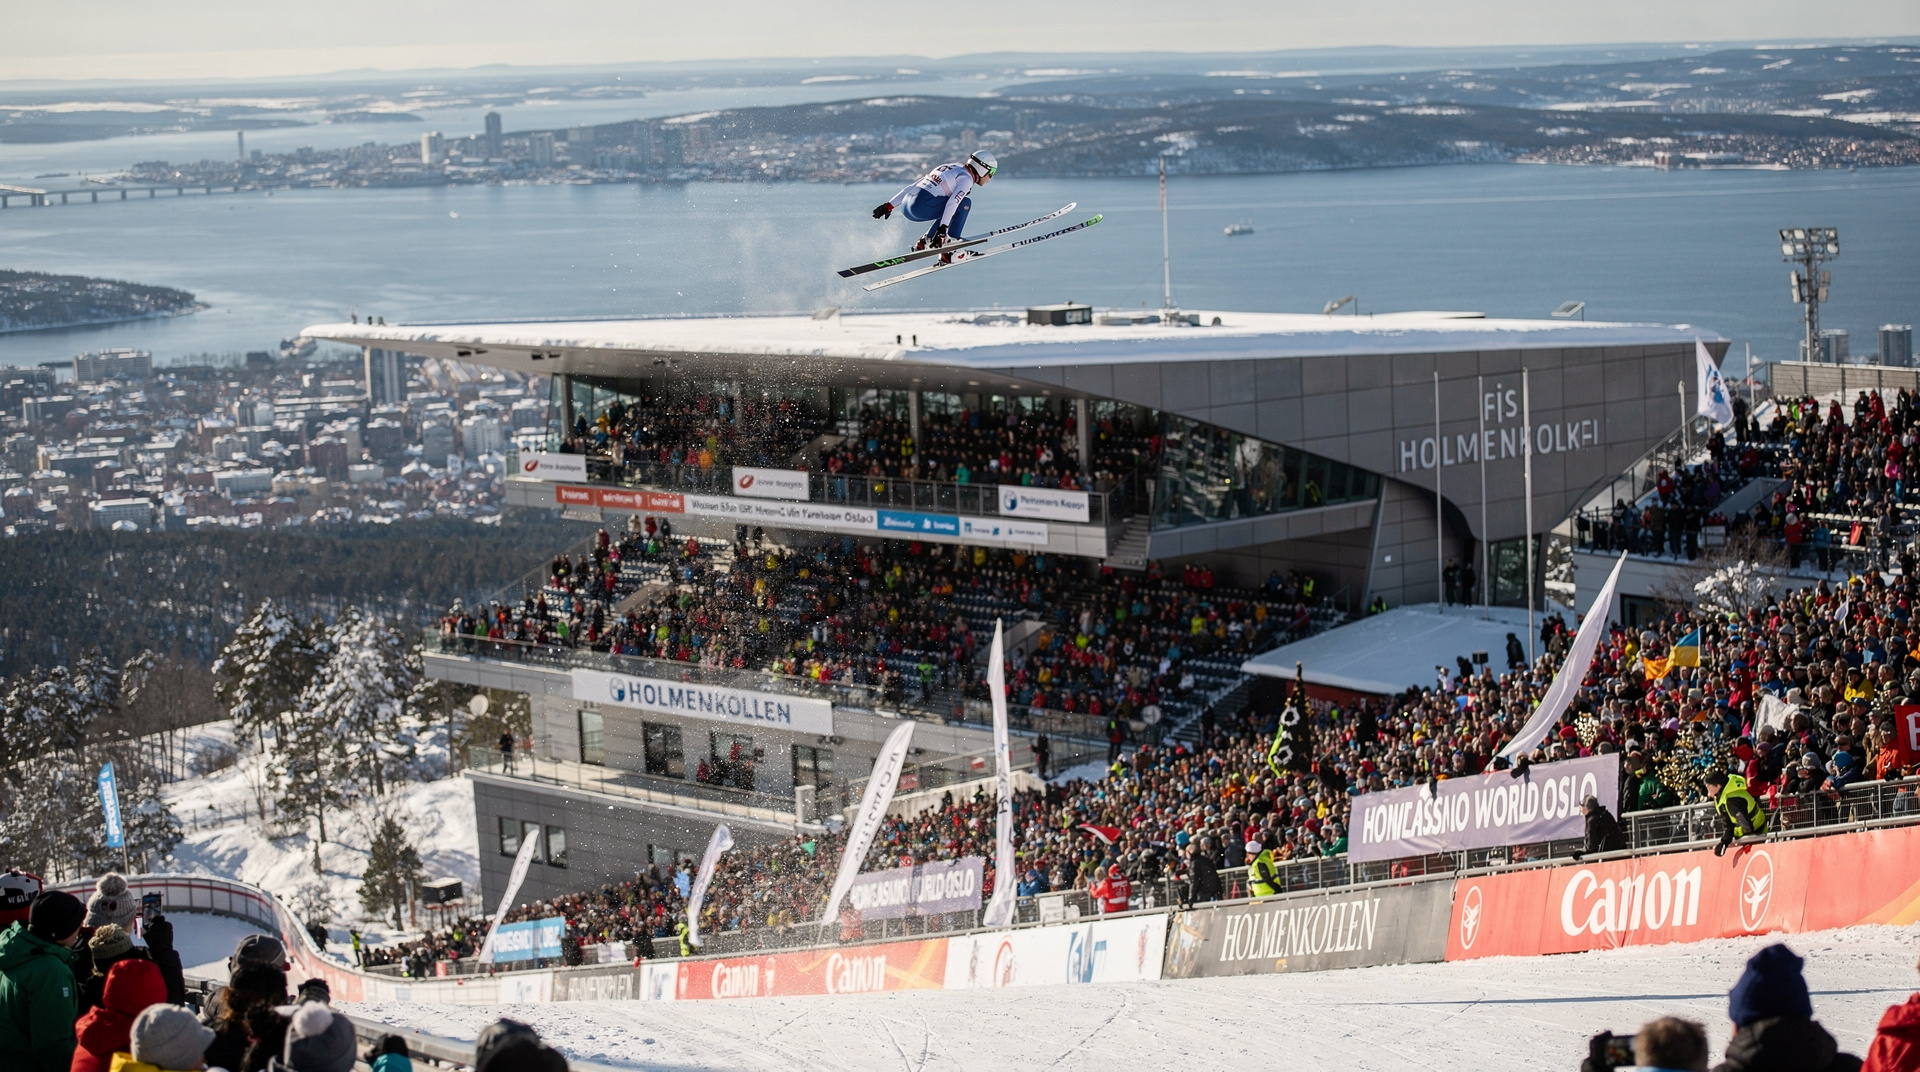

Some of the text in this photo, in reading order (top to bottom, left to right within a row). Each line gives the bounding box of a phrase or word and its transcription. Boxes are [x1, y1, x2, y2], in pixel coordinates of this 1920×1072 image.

[628, 681, 791, 724] HOLMENKOLLEN
[1474, 781, 1540, 829] WORLD
[1560, 865, 1702, 936] Canon
[1219, 898, 1381, 962] HOLMENKOLLEN
[711, 962, 759, 999] Canon
[825, 952, 887, 996] Canon
